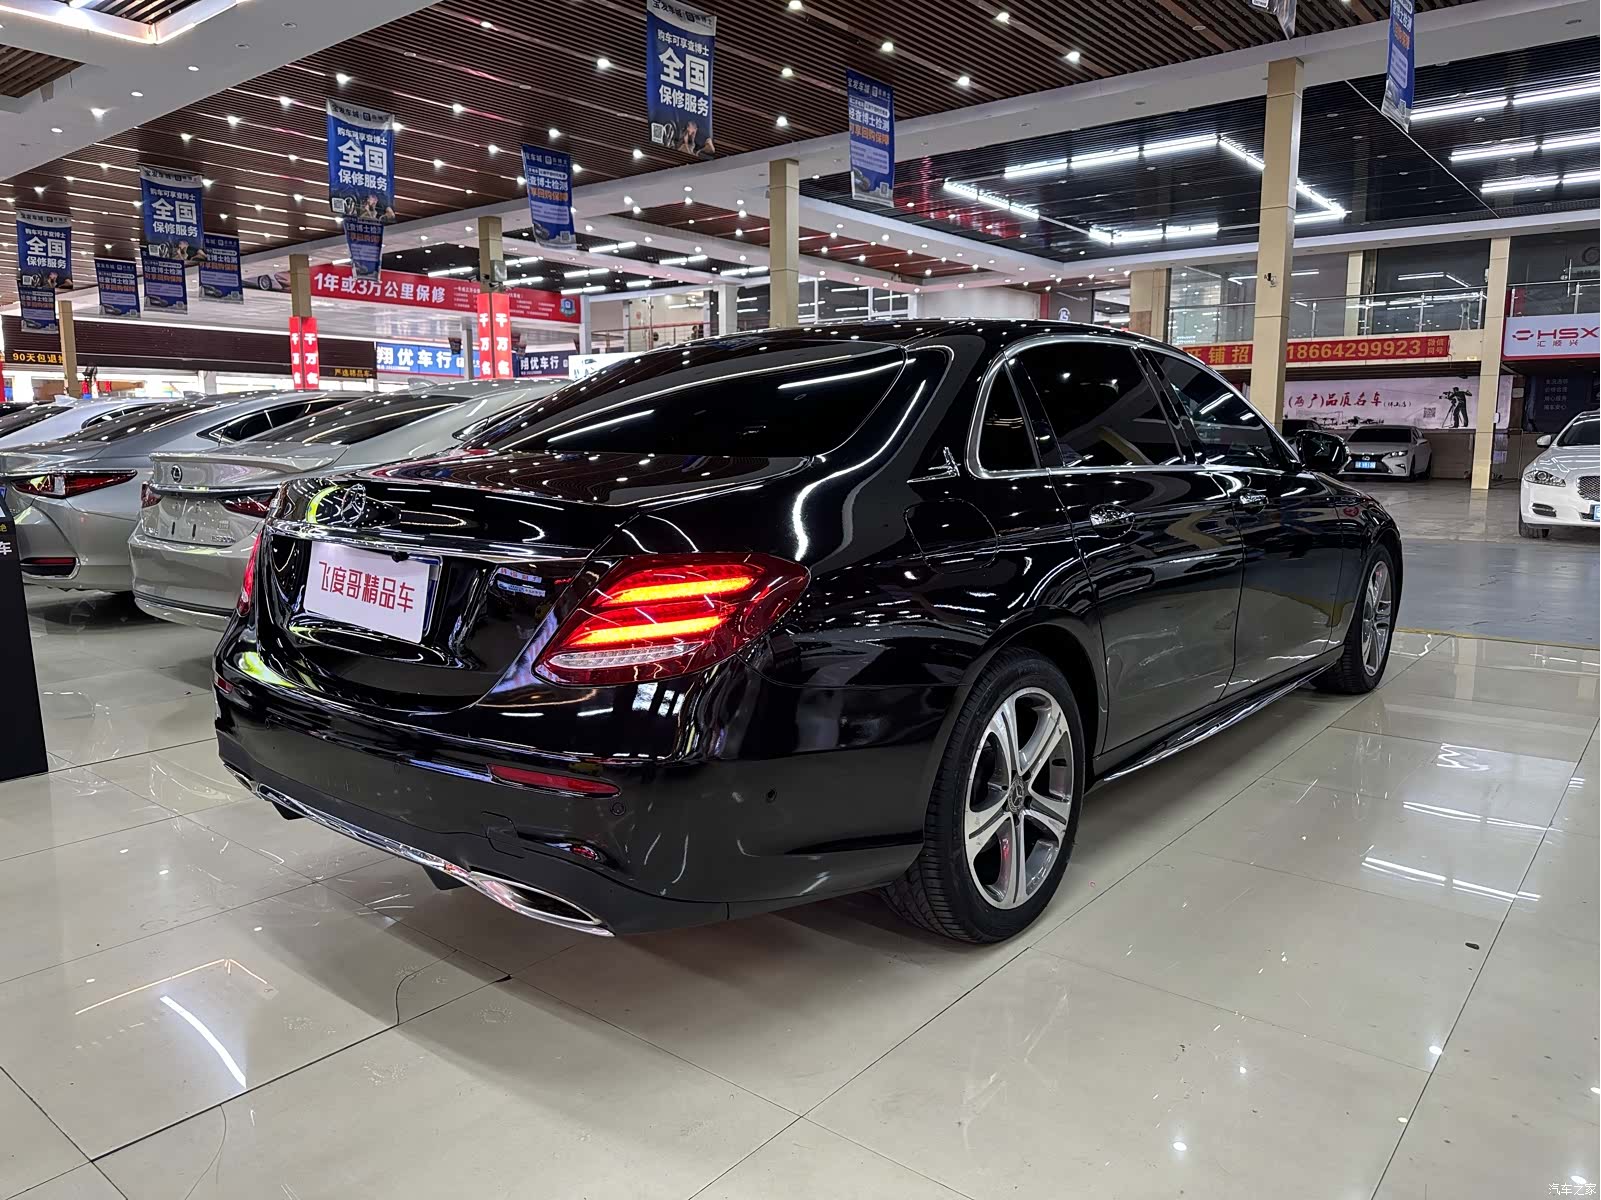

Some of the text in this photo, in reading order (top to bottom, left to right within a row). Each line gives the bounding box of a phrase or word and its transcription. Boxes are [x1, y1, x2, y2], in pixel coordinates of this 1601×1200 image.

[657, 29, 709, 56] 购车可享查博士
[659, 47, 709, 96] 全国
[659, 84, 709, 117] 保修服务
[337, 126, 387, 146] 购车可享查博士
[338, 139, 387, 176] 全国
[338, 168, 387, 191] 保修服务
[528, 176, 568, 191] 查博士检测
[152, 198, 197, 224] 全国
[153, 221, 198, 237] 保修服务
[26, 236, 66, 258] 全国
[27, 256, 66, 269] 保修服务
[314, 272, 446, 304] 1年或3万公里保修
[1537, 327, 1599, 340] HSX
[1287, 339, 1421, 360] 18664299923
[520, 355, 559, 370] 翔优车行
[319, 561, 415, 613] 飞度哥精品车
